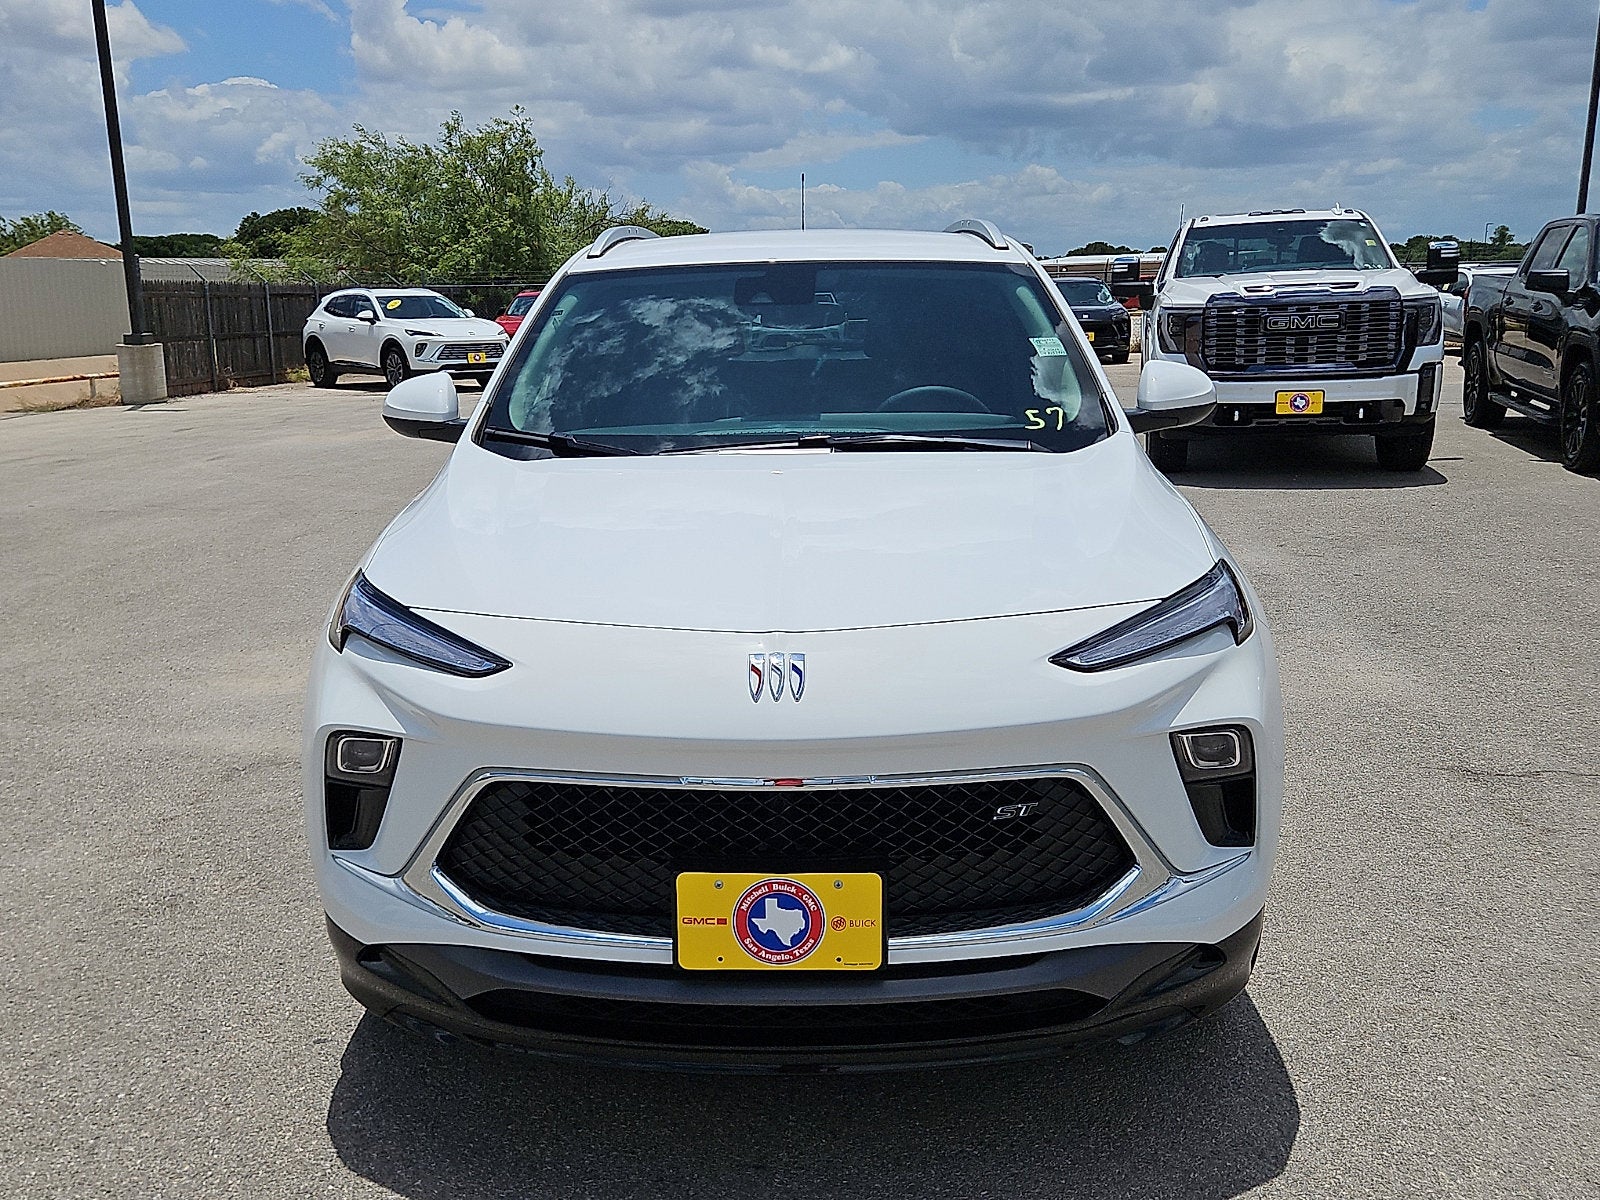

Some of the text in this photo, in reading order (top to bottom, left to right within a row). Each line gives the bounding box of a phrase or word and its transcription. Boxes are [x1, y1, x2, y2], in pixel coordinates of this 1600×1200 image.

[1267, 314, 1340, 330] GMC
[1024, 406, 1065, 431] 57
[993, 801, 1039, 820] ST
[740, 883, 818, 912] Mitchell Buick GMC
[682, 917, 716, 925] GMC
[849, 919, 877, 928] BUICK
[743, 937, 815, 961] San Angelo, Texas
